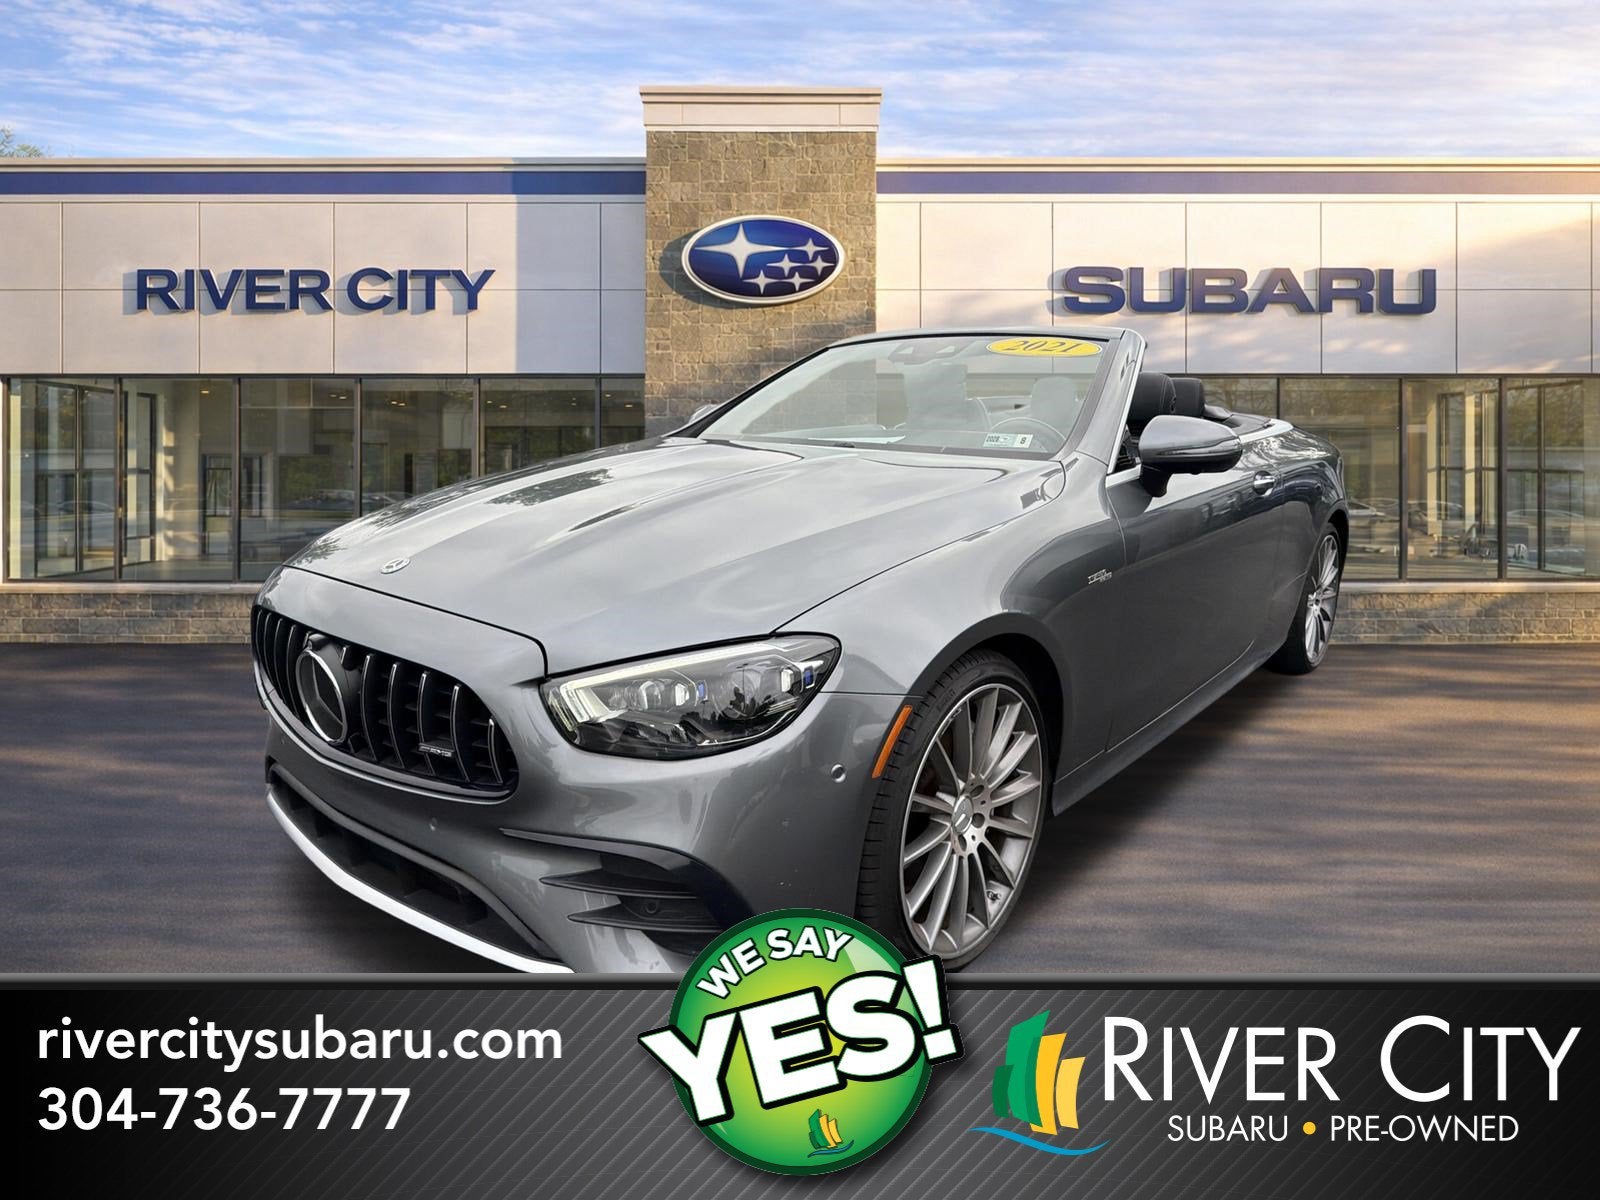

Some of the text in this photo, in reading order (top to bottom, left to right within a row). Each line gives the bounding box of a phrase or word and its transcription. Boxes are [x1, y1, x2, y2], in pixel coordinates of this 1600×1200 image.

[135, 266, 496, 311] RIVER CITY
[1064, 266, 1437, 314] SUBARU
[1001, 340, 1083, 353] 2021
